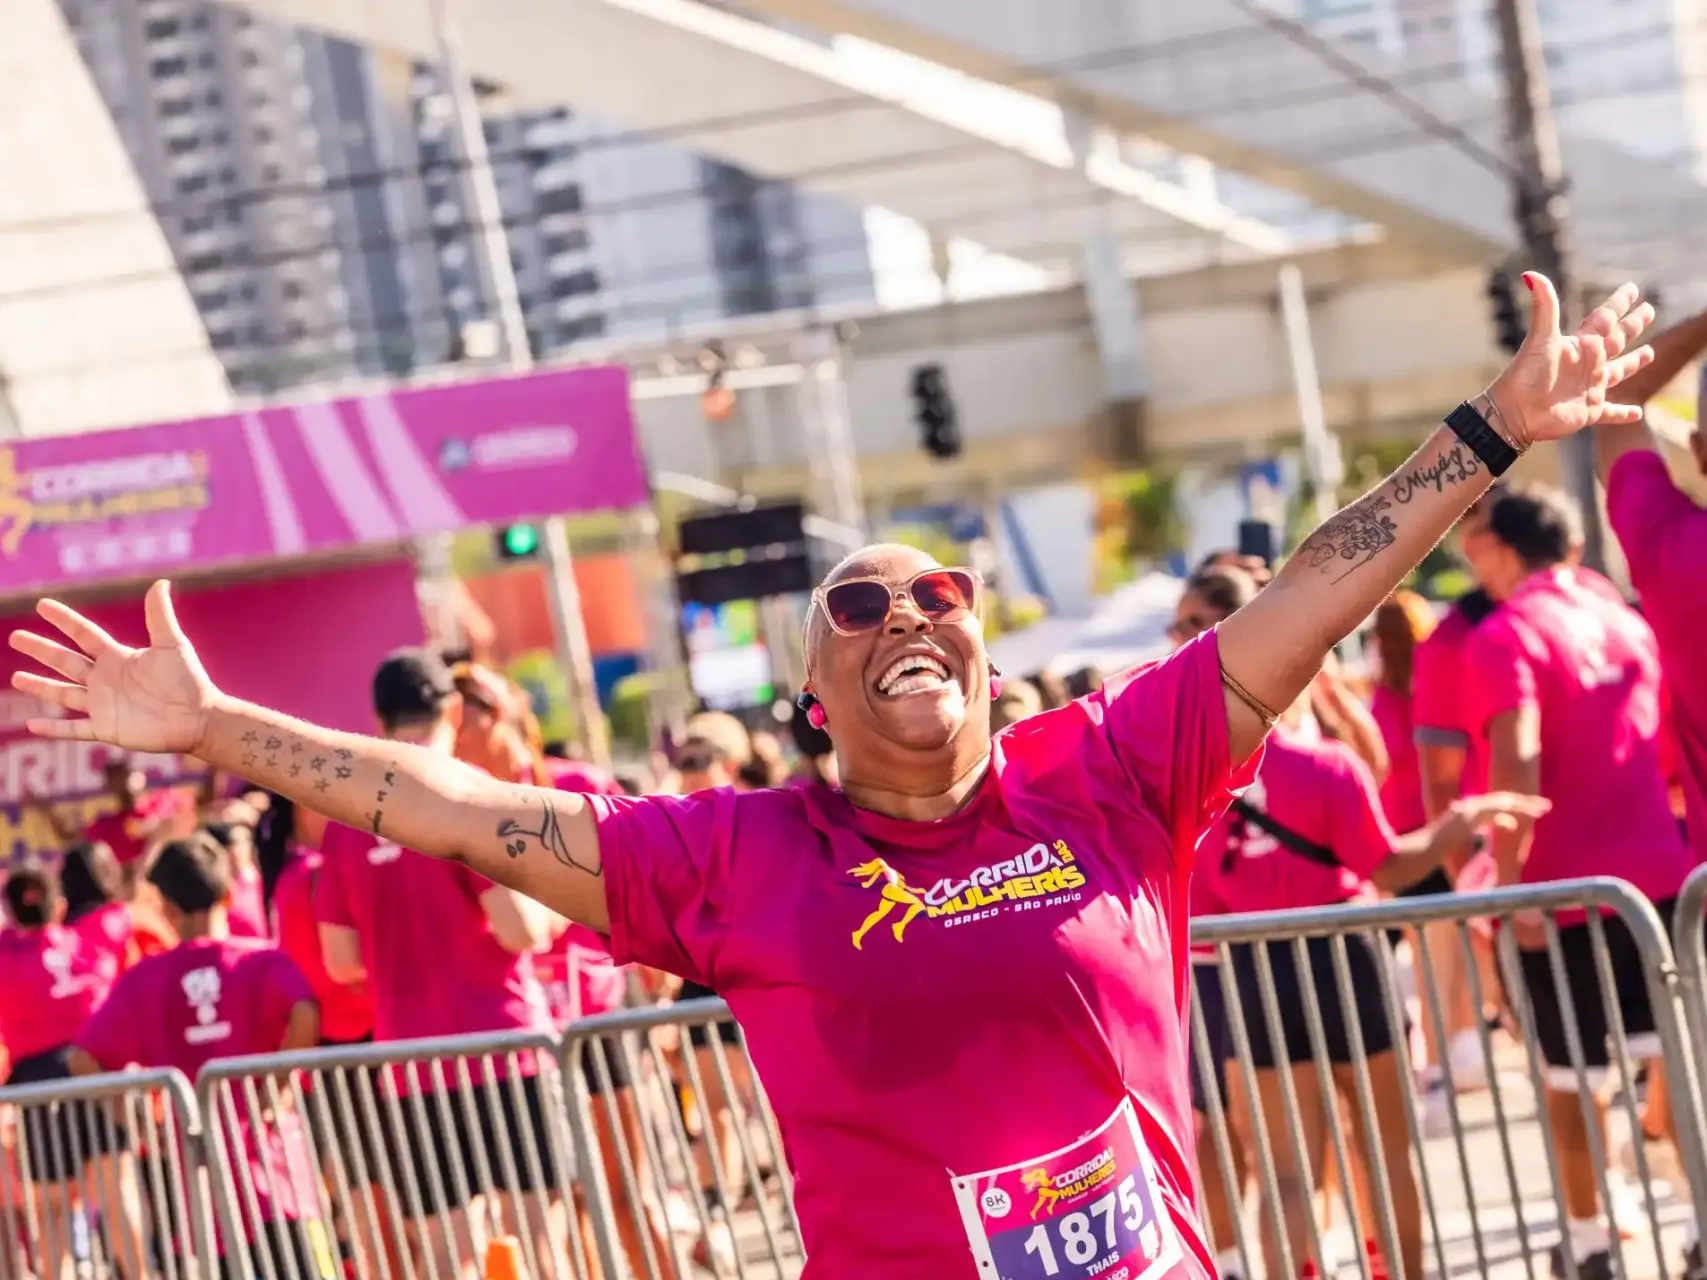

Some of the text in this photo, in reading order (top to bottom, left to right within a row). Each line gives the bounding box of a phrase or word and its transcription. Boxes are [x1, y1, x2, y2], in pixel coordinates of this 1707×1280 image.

[924, 843, 1064, 906] CORRIDA
[944, 907, 999, 929] OSASCO
[1014, 900, 1042, 912] SÃO
[1046, 892, 1082, 907] PAULO
[1055, 1148, 1110, 1188] CORRIDA
[985, 1193, 1007, 1207] 8K
[1024, 1173, 1144, 1277] 1875
[1086, 1250, 1120, 1277] THAIS
